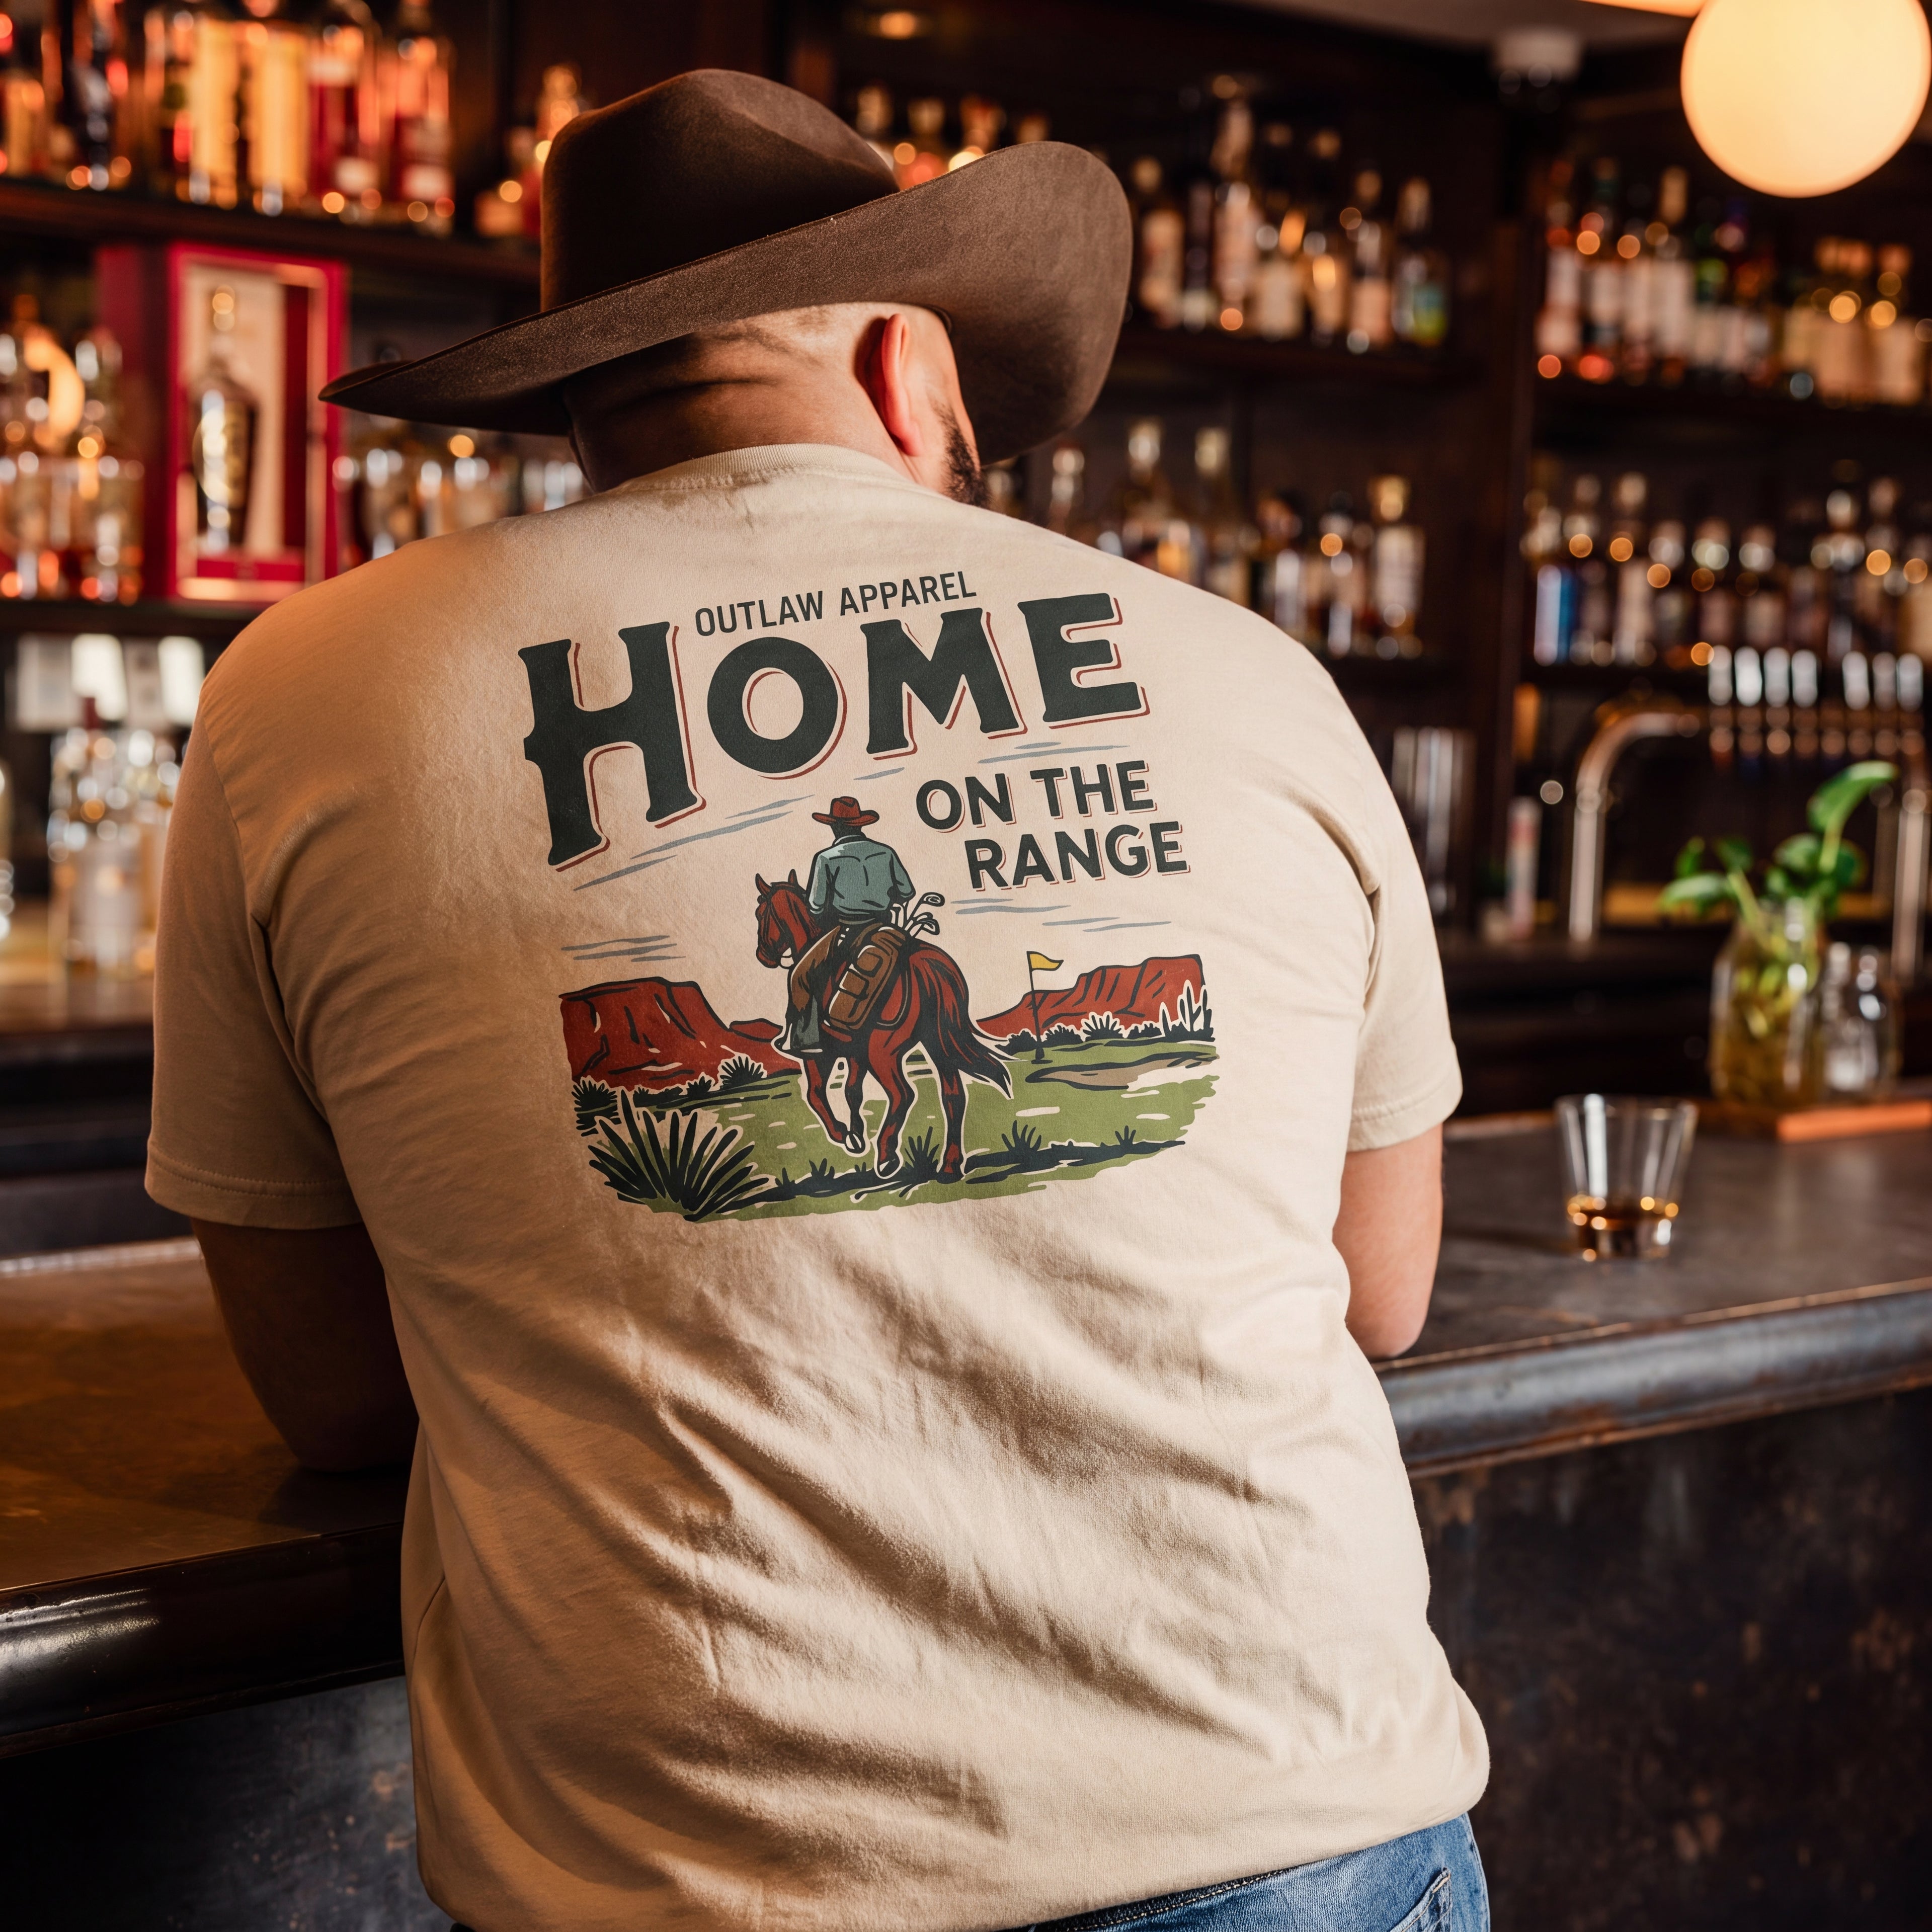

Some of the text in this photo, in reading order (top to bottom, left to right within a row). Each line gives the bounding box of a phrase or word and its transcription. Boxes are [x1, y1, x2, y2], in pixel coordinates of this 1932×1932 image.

[695, 571, 977, 635] OUTLAW APPAREL
[518, 593, 1150, 872] HOME
[916, 760, 1157, 833] ON THE
[963, 821, 1191, 893] RANGE
